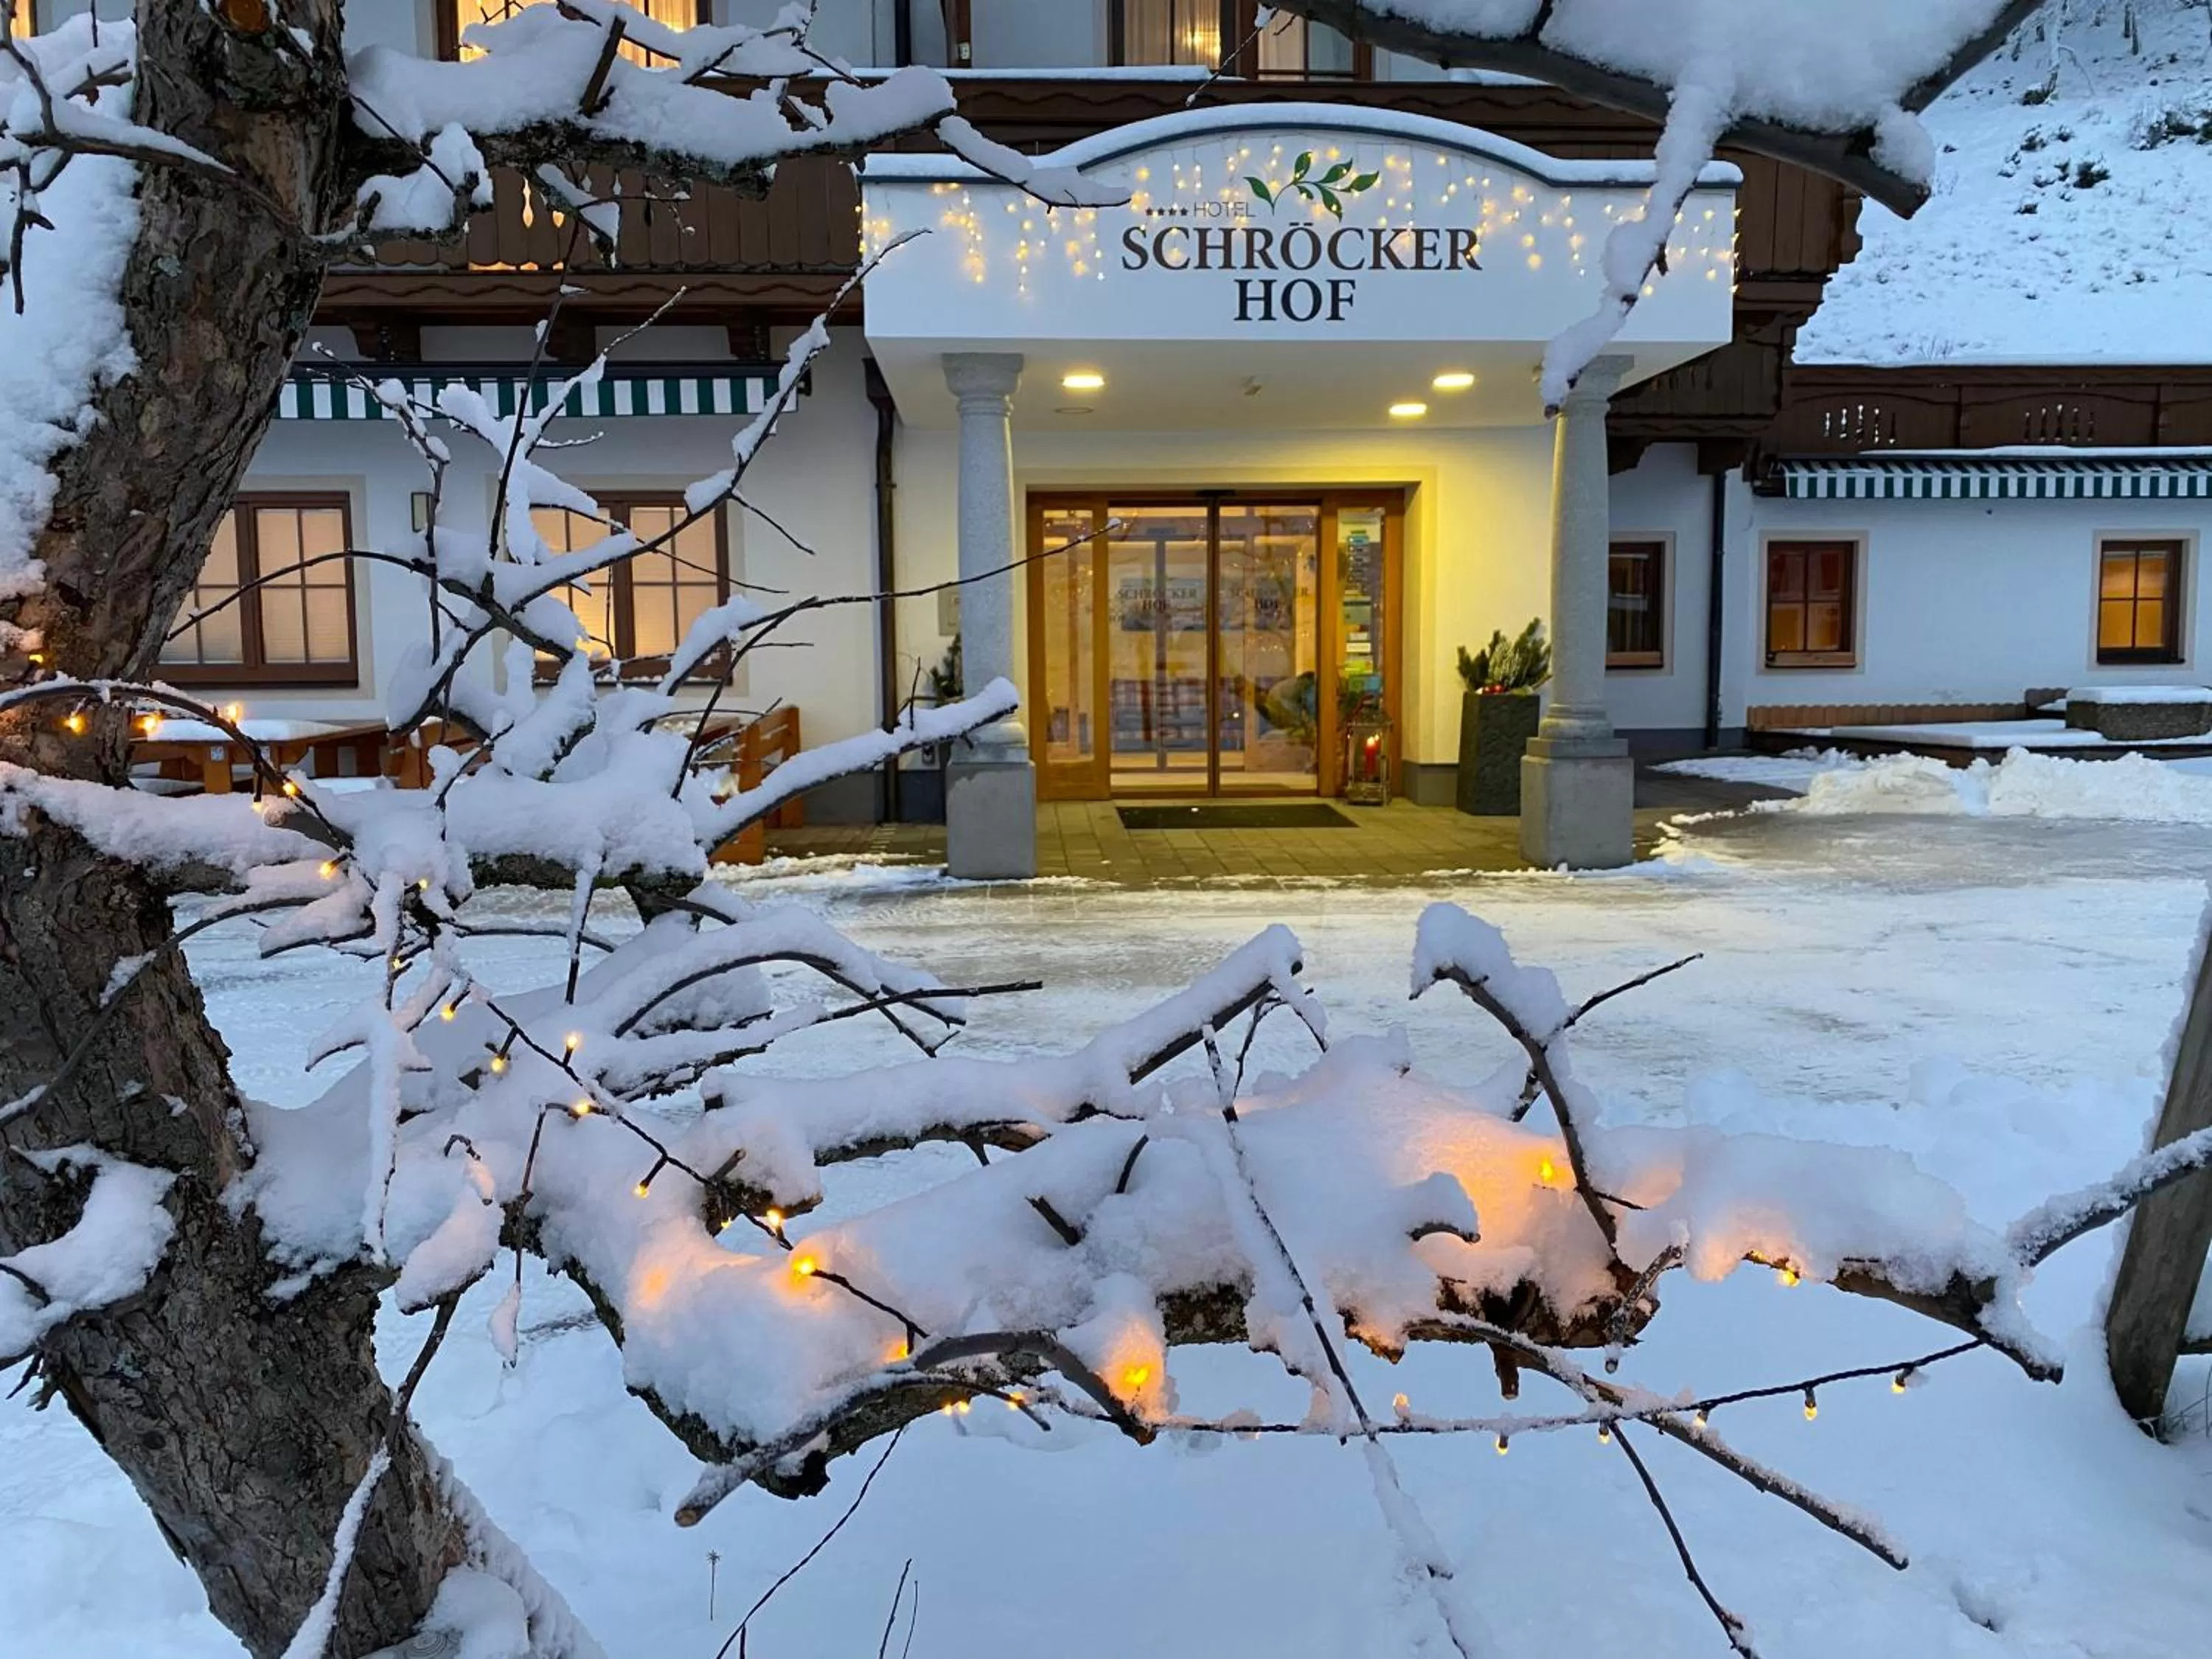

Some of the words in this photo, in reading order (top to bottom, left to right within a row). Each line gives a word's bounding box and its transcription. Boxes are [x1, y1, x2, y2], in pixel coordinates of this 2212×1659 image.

[1194, 201, 1256, 218] HOTEL
[1121, 222, 1483, 271] SCHRÖCKER
[1234, 278, 1357, 321] HOF
